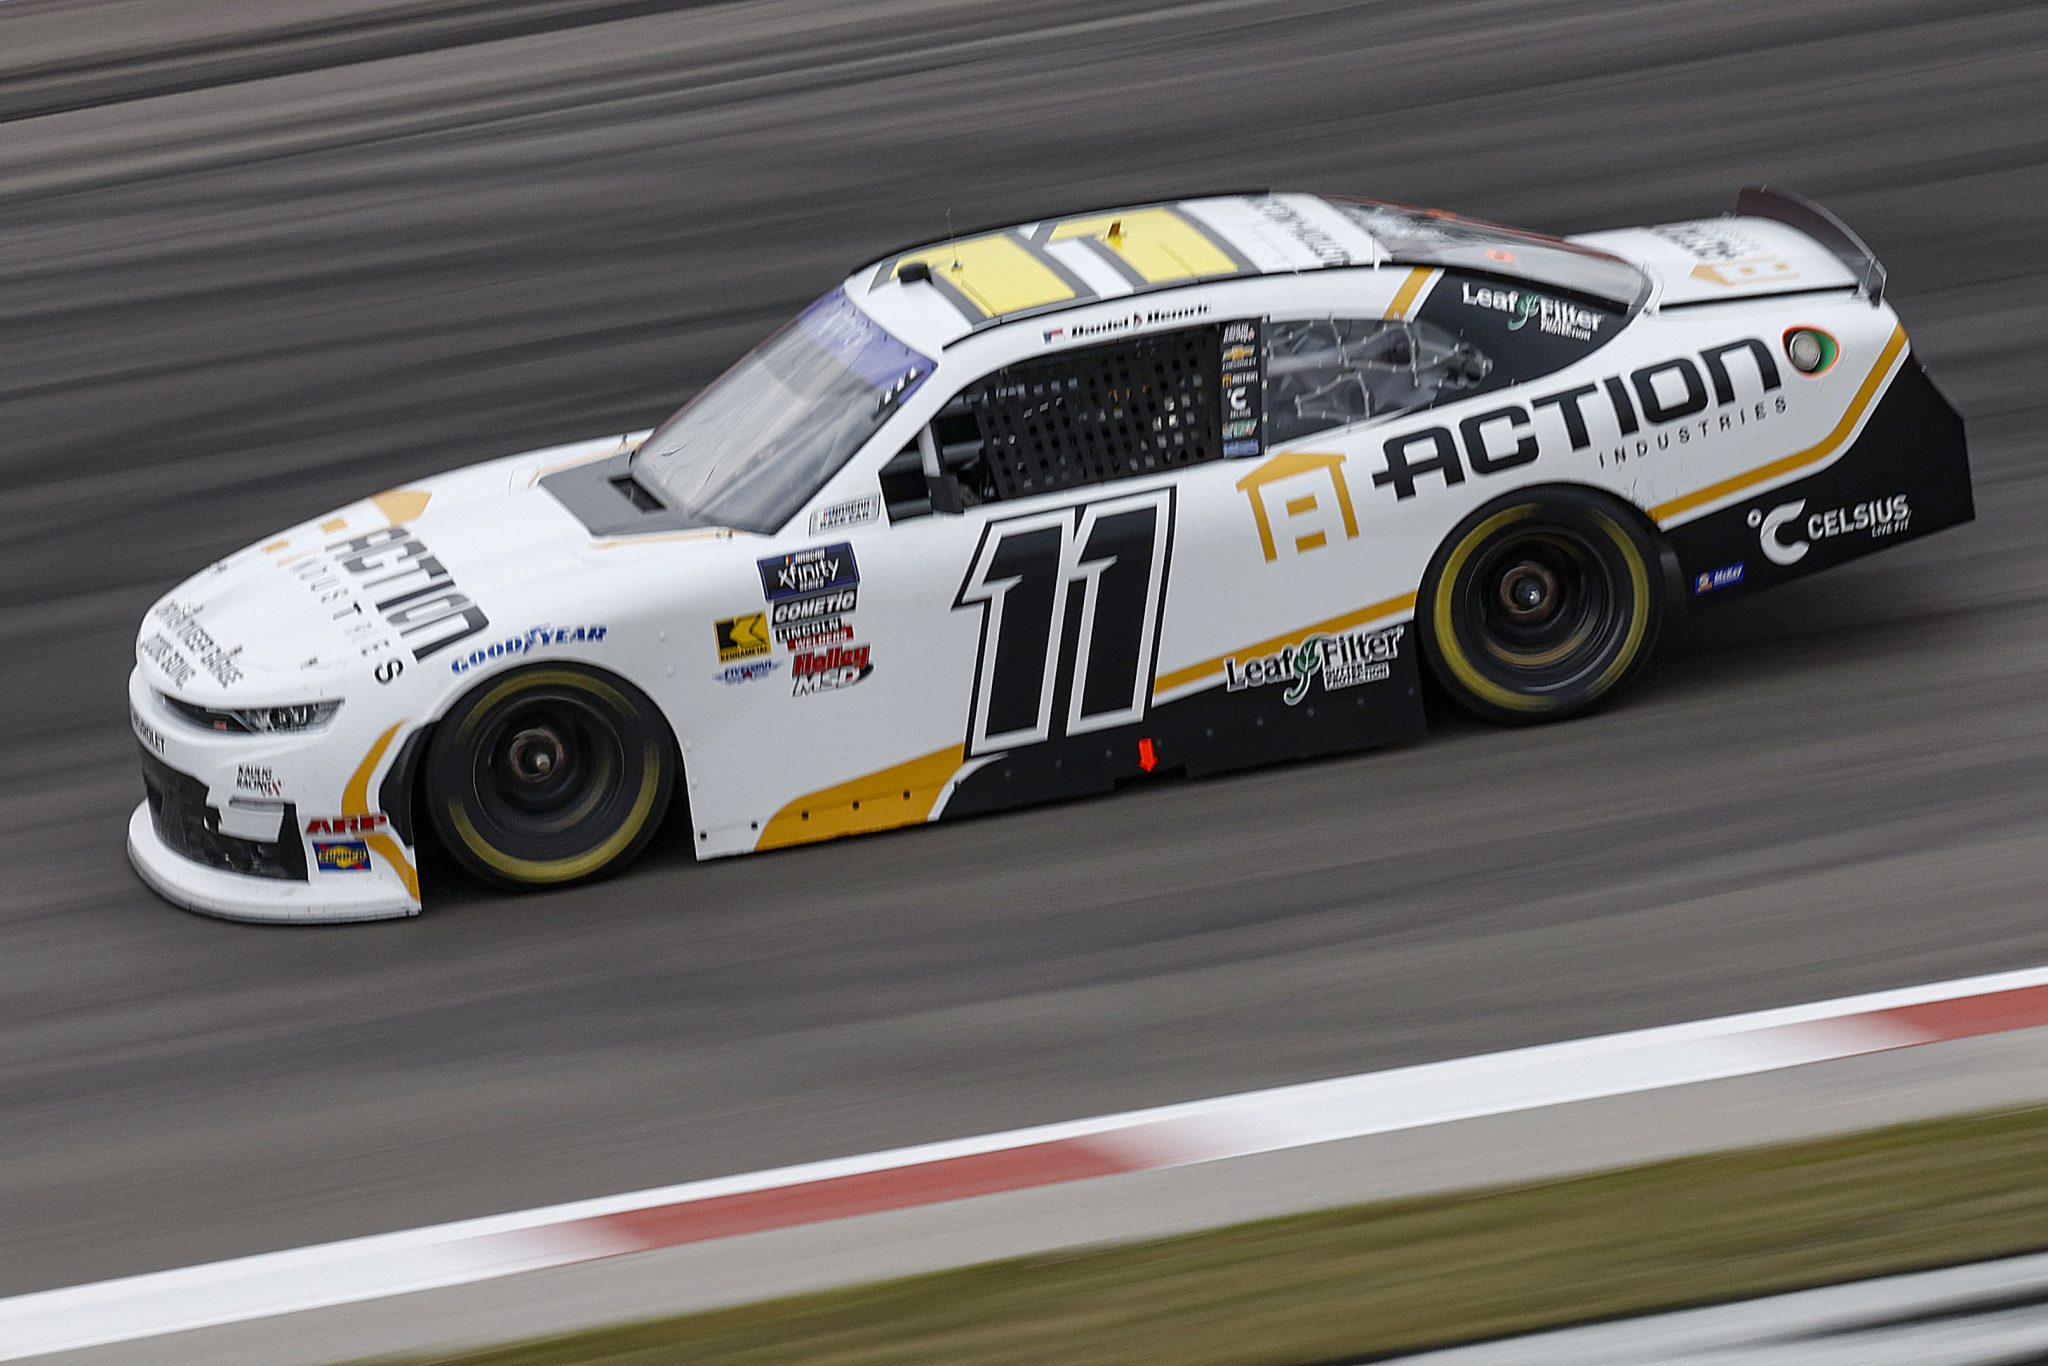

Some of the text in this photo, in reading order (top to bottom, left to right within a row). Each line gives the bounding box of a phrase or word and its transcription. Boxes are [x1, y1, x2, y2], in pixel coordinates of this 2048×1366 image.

[1373, 338, 1781, 501] ACTION
[1598, 396, 1788, 470] INDUSTRIES
[1807, 494, 1909, 540] CELSIUS
[778, 557, 839, 590] xfinity
[288, 555, 404, 686] NDUSTRIES
[774, 588, 856, 624] COMETIC
[778, 616, 842, 641] LINCOLN
[952, 484, 1178, 763] 11
[451, 624, 607, 674] GOODYEAR
[793, 643, 870, 678] Holley
[1223, 644, 1294, 692] Leaf
[792, 668, 863, 697] MSD
[131, 704, 166, 756] VROLET
[305, 814, 387, 836] ARP
